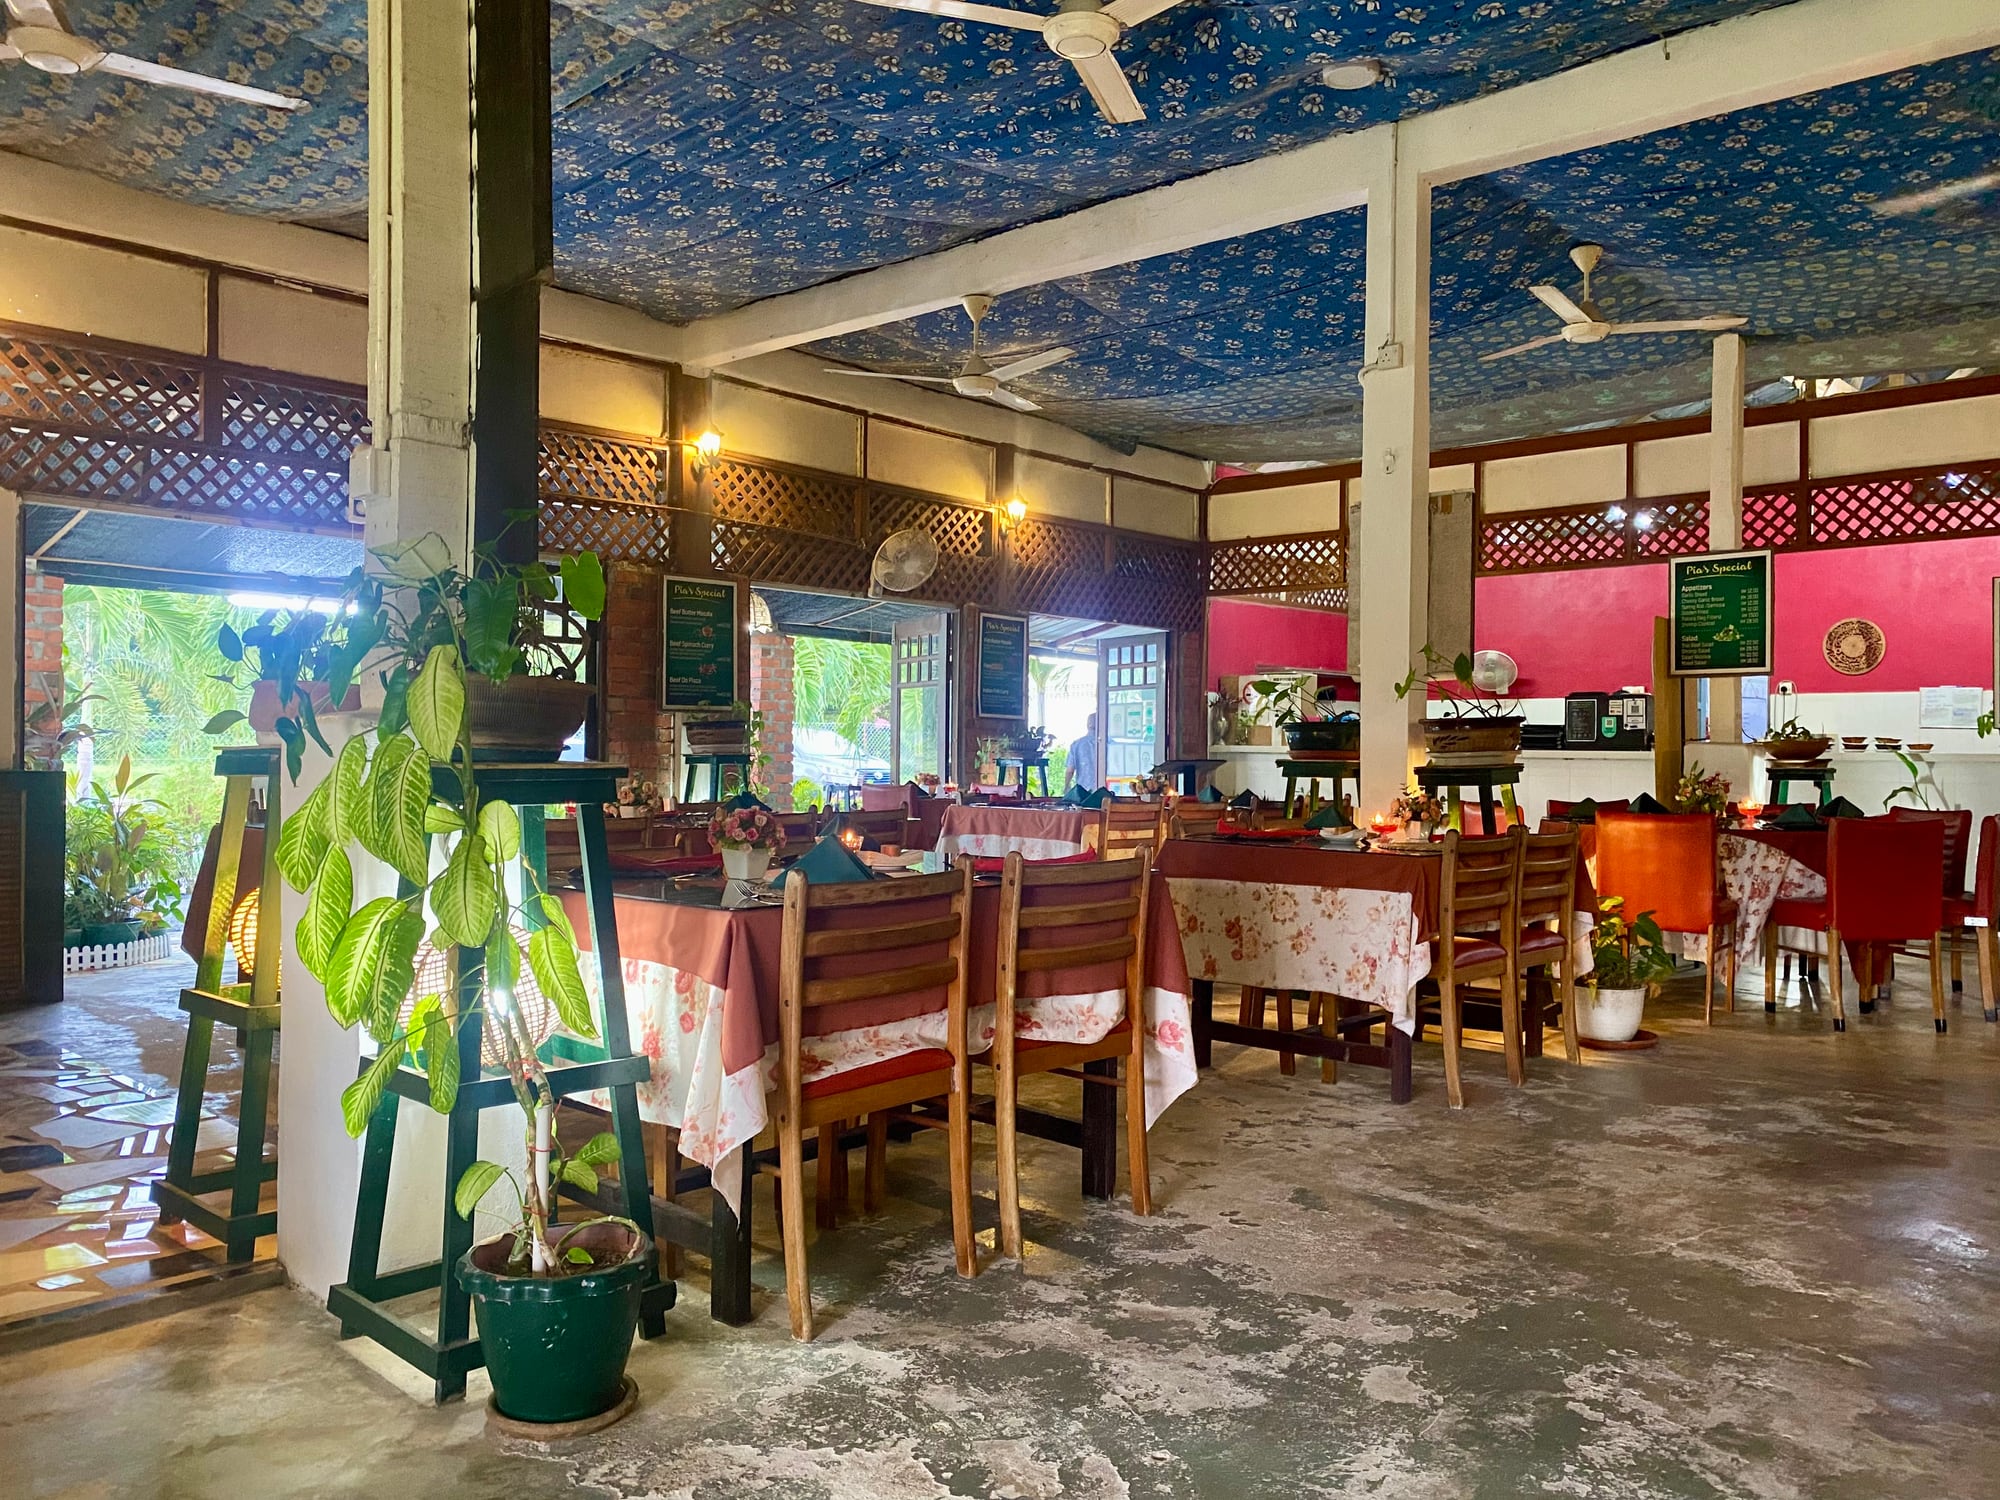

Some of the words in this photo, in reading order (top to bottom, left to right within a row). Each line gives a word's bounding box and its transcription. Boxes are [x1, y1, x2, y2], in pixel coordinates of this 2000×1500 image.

[1686, 565, 1709, 575] Pia's
[1712, 561, 1752, 574] Special
[694, 586, 726, 599] Special
